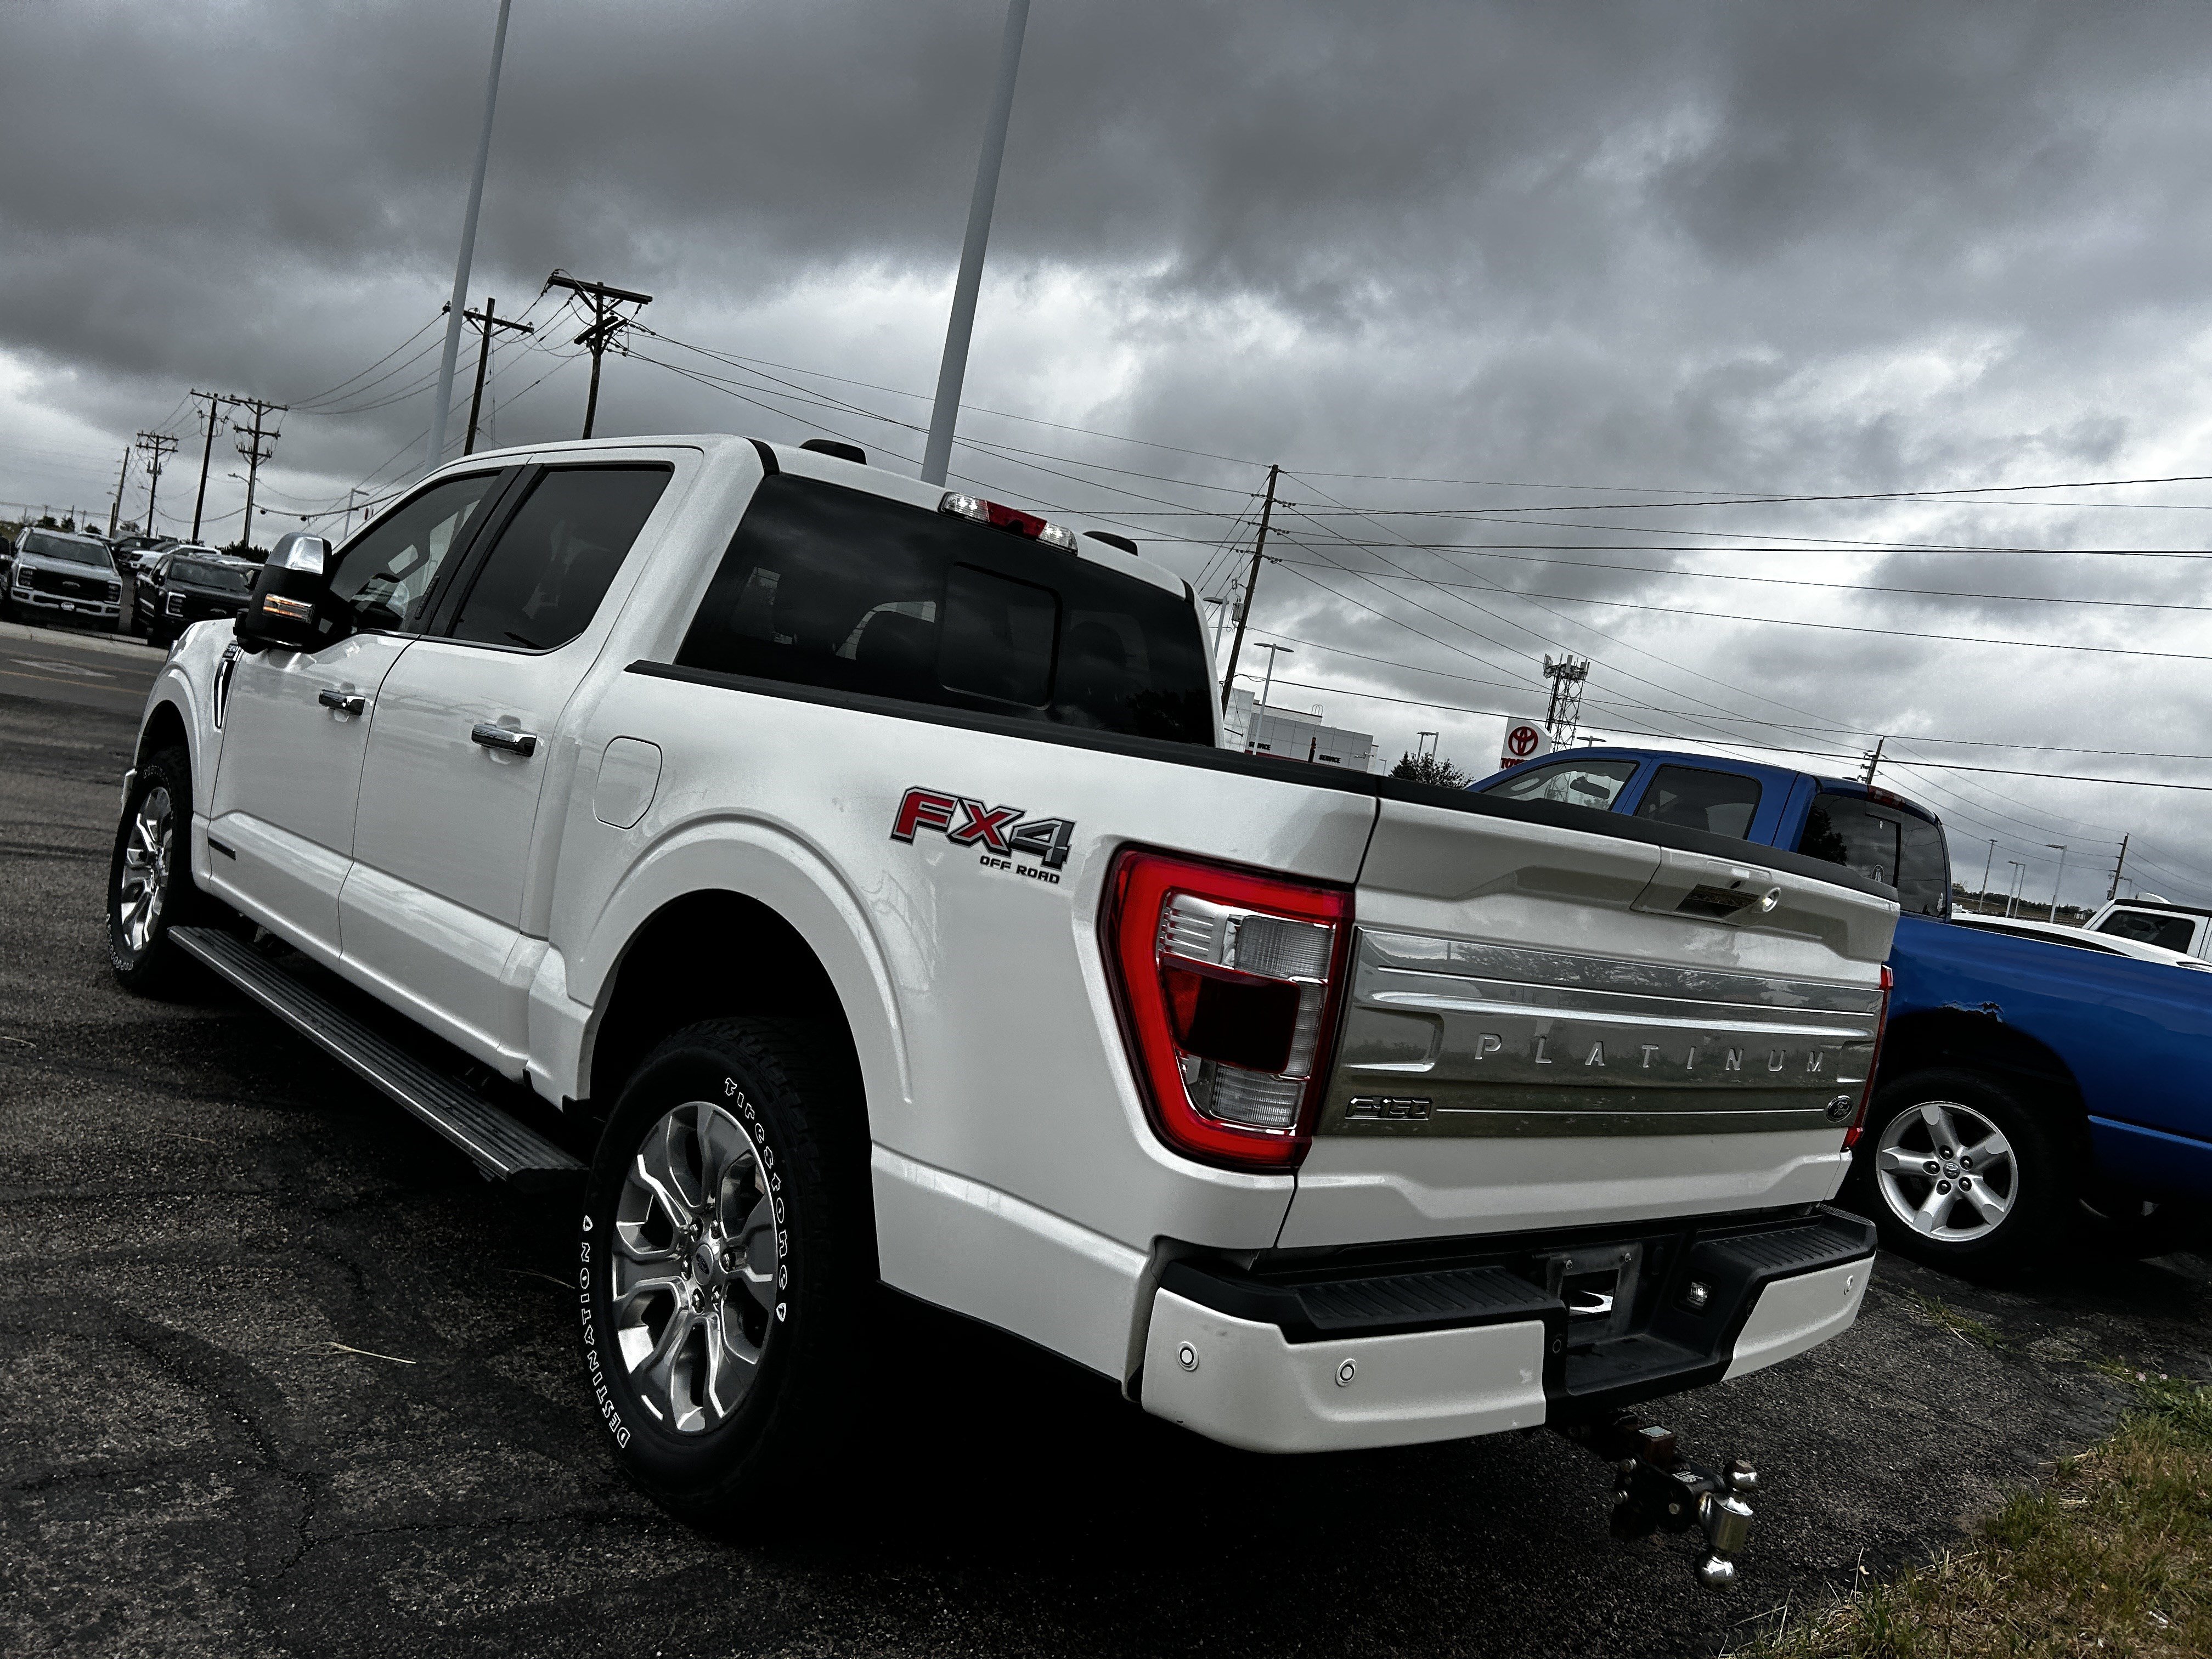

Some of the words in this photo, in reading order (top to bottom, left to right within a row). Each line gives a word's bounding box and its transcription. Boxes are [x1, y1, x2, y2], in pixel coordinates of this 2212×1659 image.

[1319, 754, 1341, 763] SERVICE
[889, 785, 1077, 871] FX4
[980, 855, 1012, 870] OFF
[1016, 864, 1060, 884] ROAD
[1475, 1033, 1826, 1072] PLATINUM
[580, 1242, 630, 1448] DESTINATION
